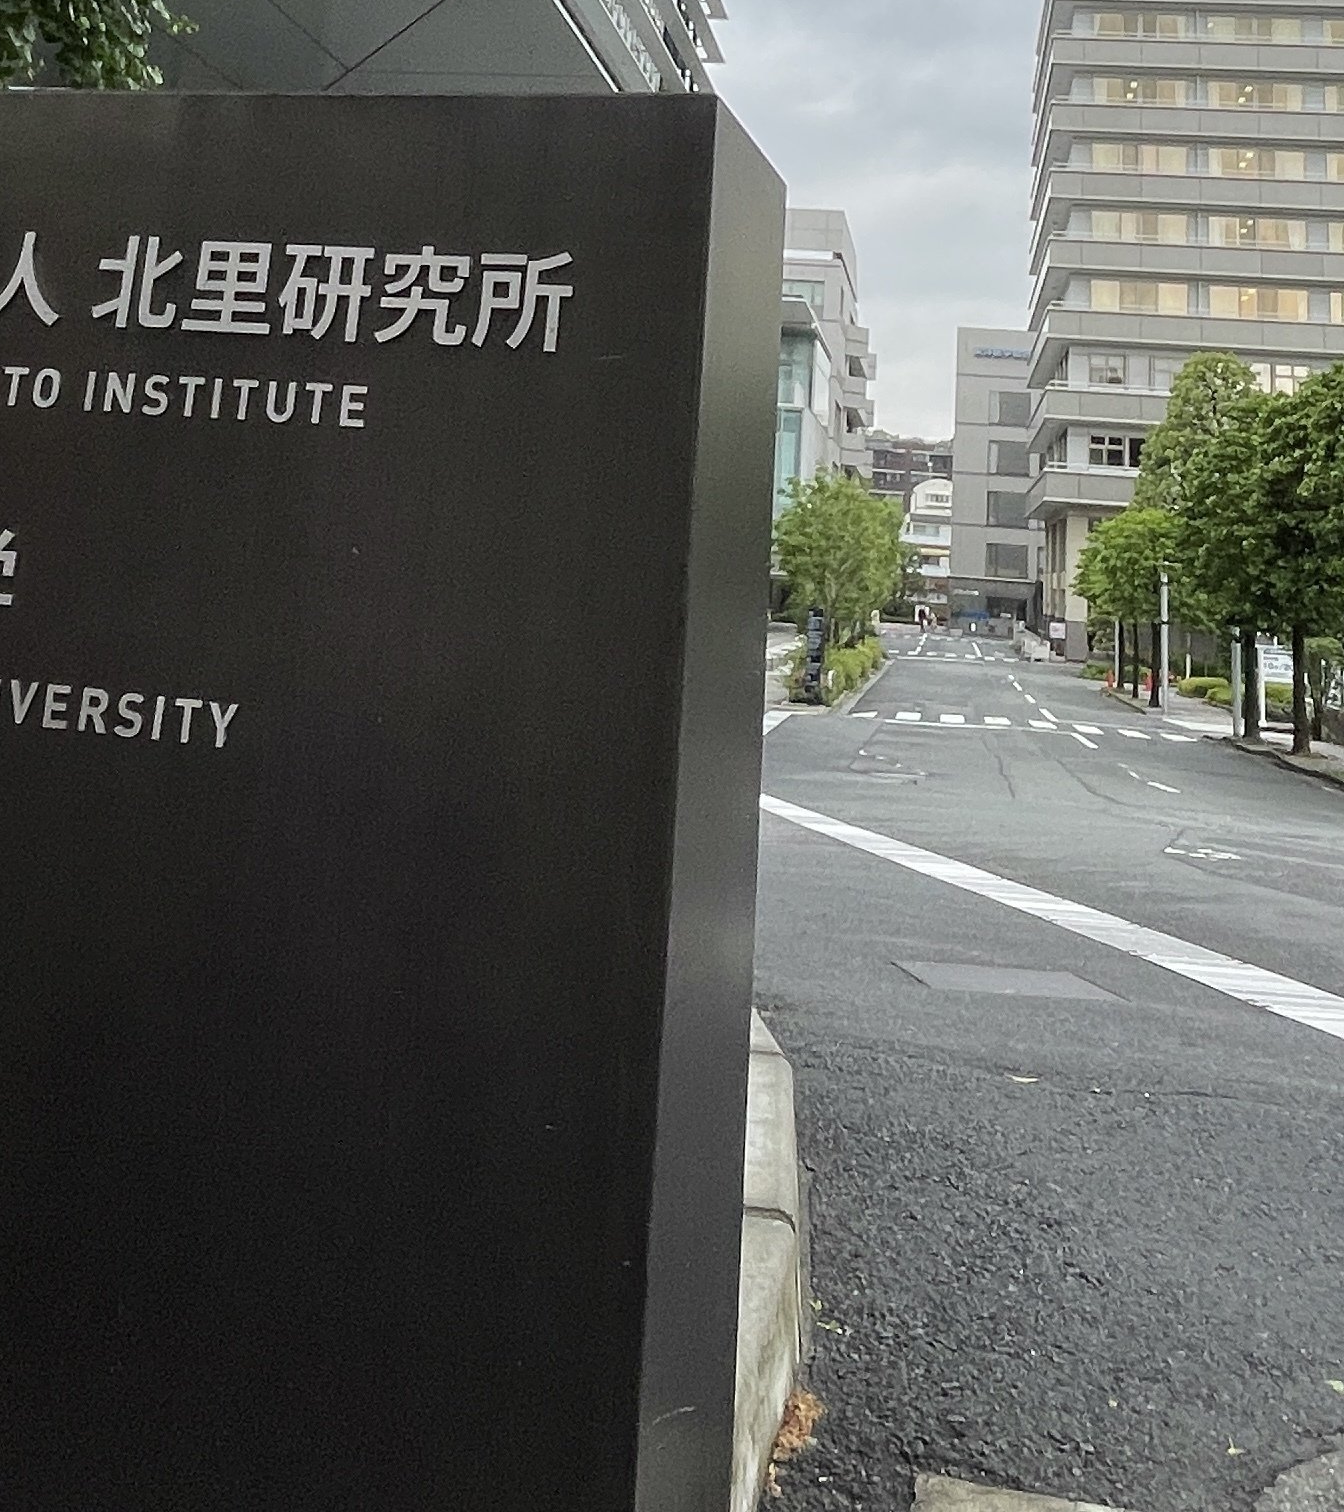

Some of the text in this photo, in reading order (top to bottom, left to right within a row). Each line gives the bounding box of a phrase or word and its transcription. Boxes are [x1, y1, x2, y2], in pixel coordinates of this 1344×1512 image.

[90, 235, 574, 353] 北里研究所
[83, 370, 369, 428] INSTITUTE
